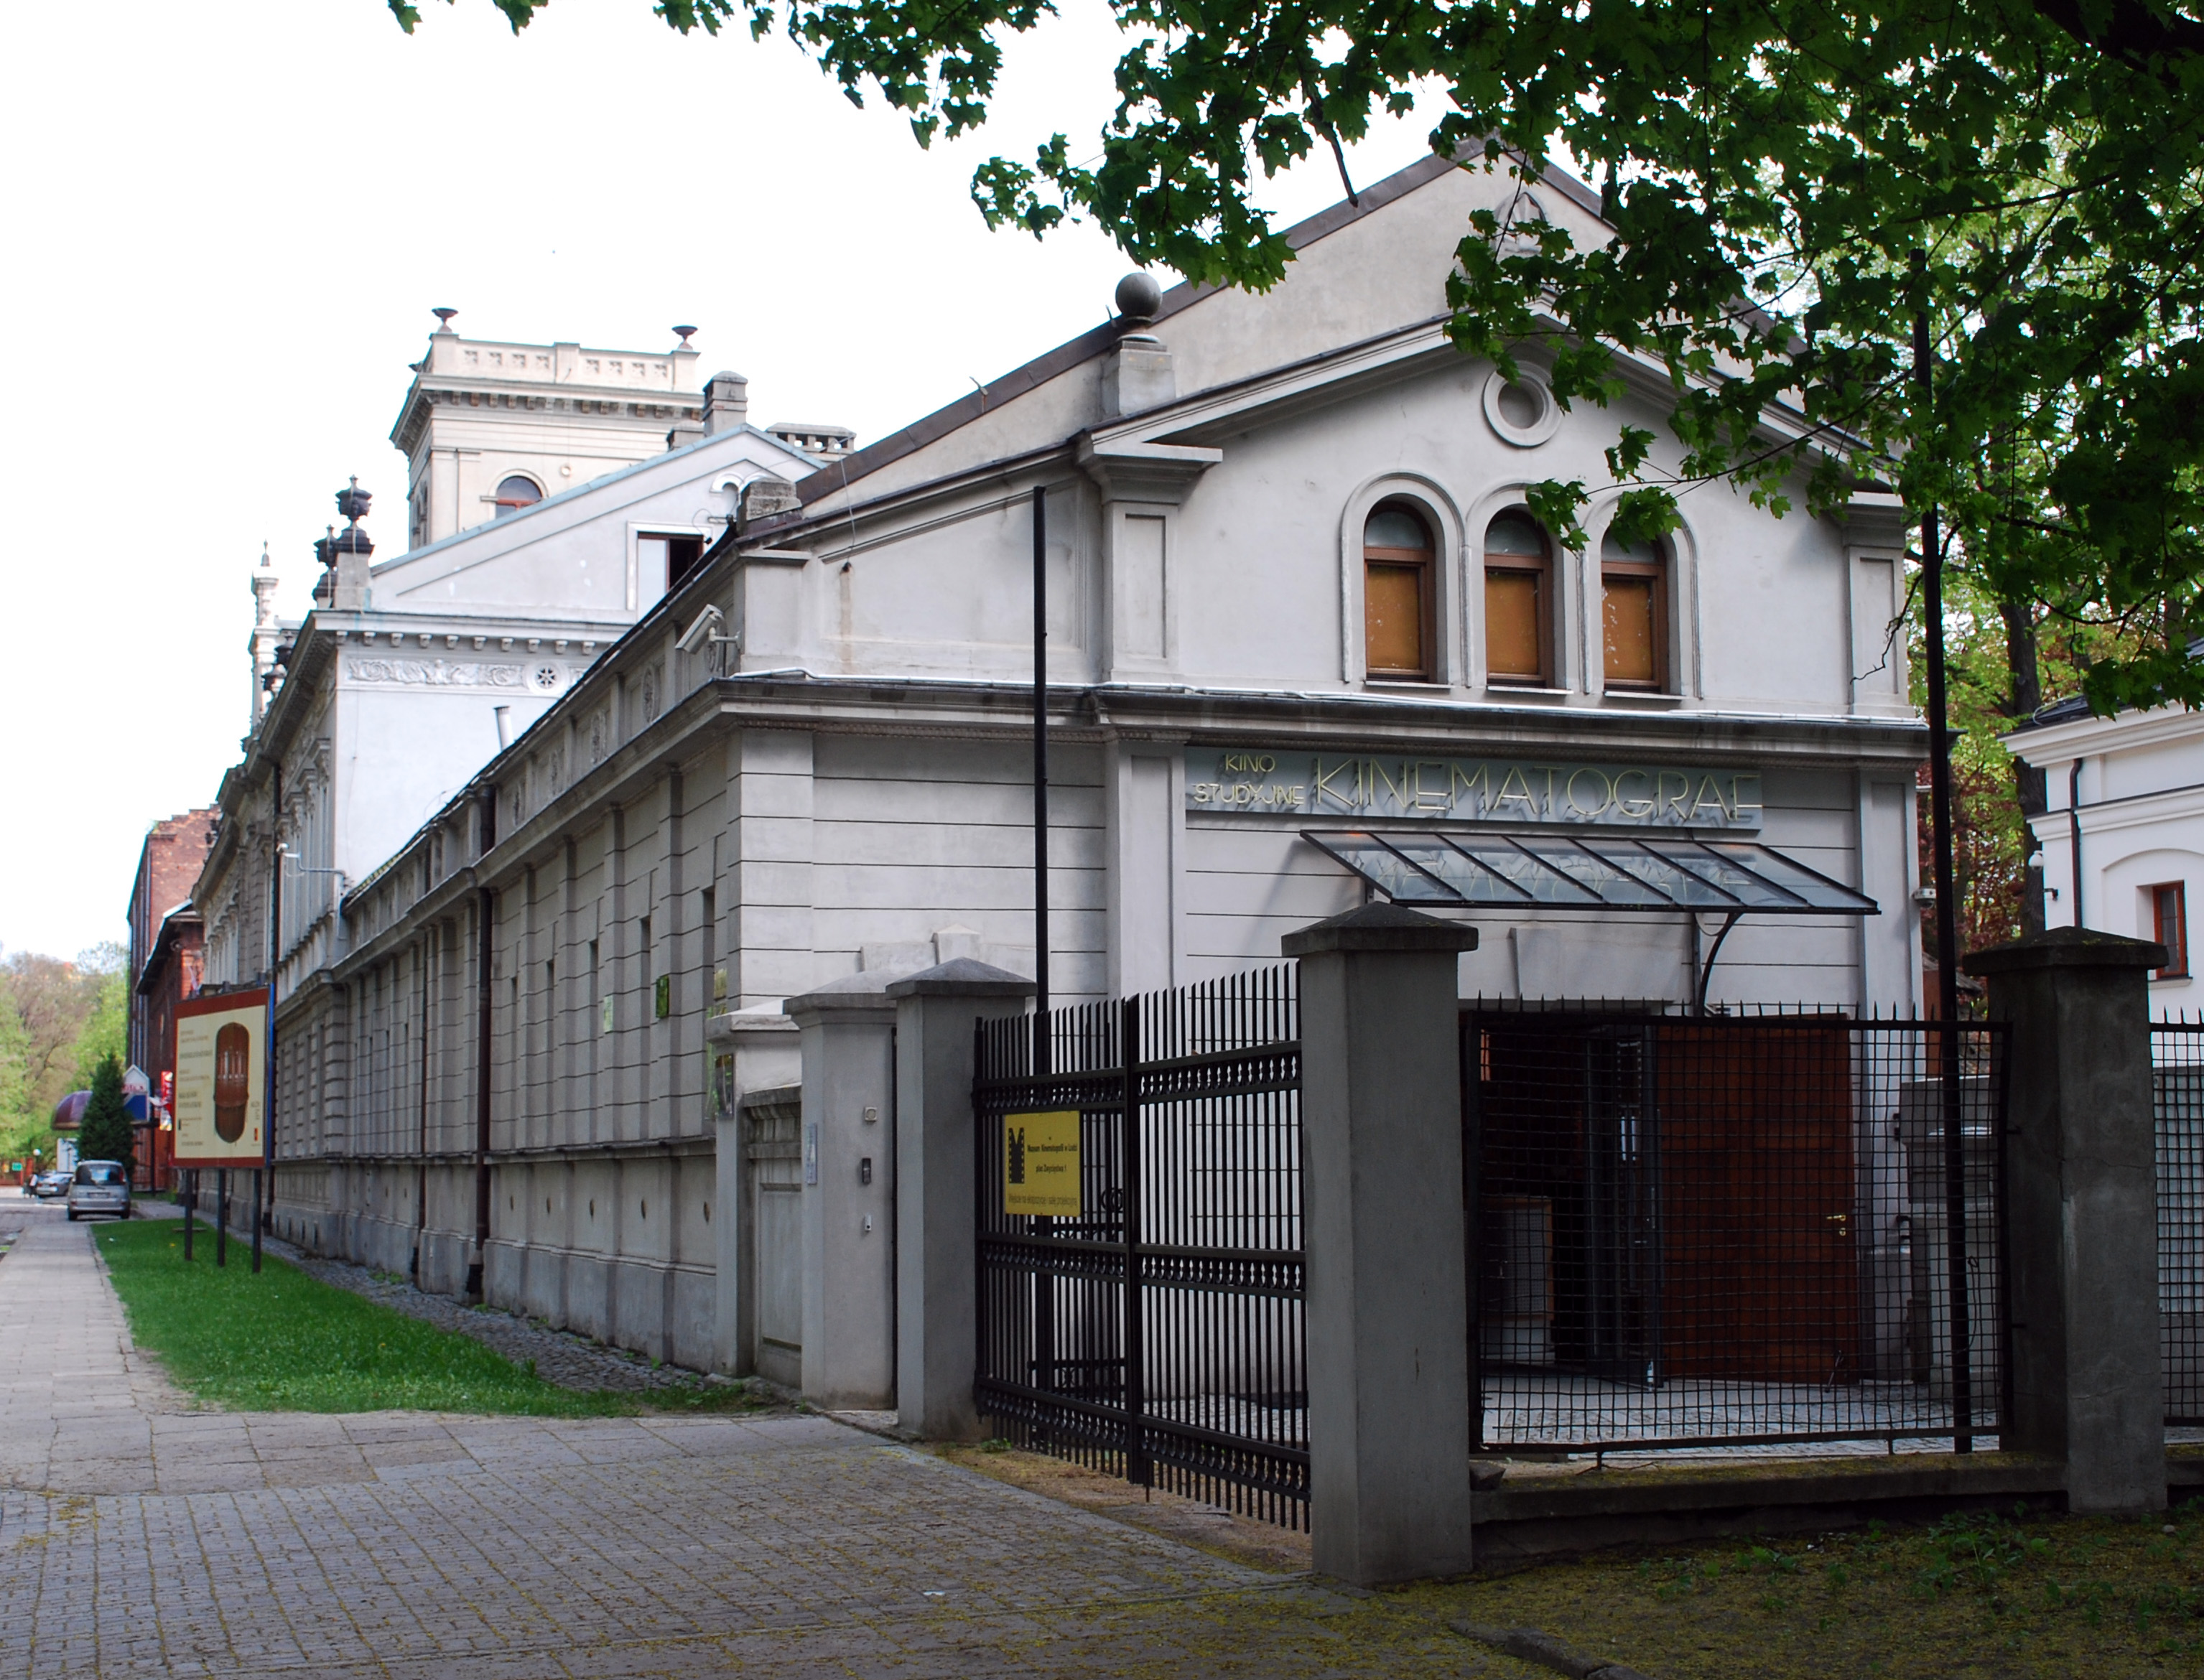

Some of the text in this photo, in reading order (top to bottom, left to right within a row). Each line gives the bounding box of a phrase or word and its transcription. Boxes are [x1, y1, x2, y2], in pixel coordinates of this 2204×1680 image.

[1224, 754, 1275, 773] KINO
[1194, 782, 1304, 805] STUDYJNE
[1316, 757, 1763, 821] KINEMATOGRAF
